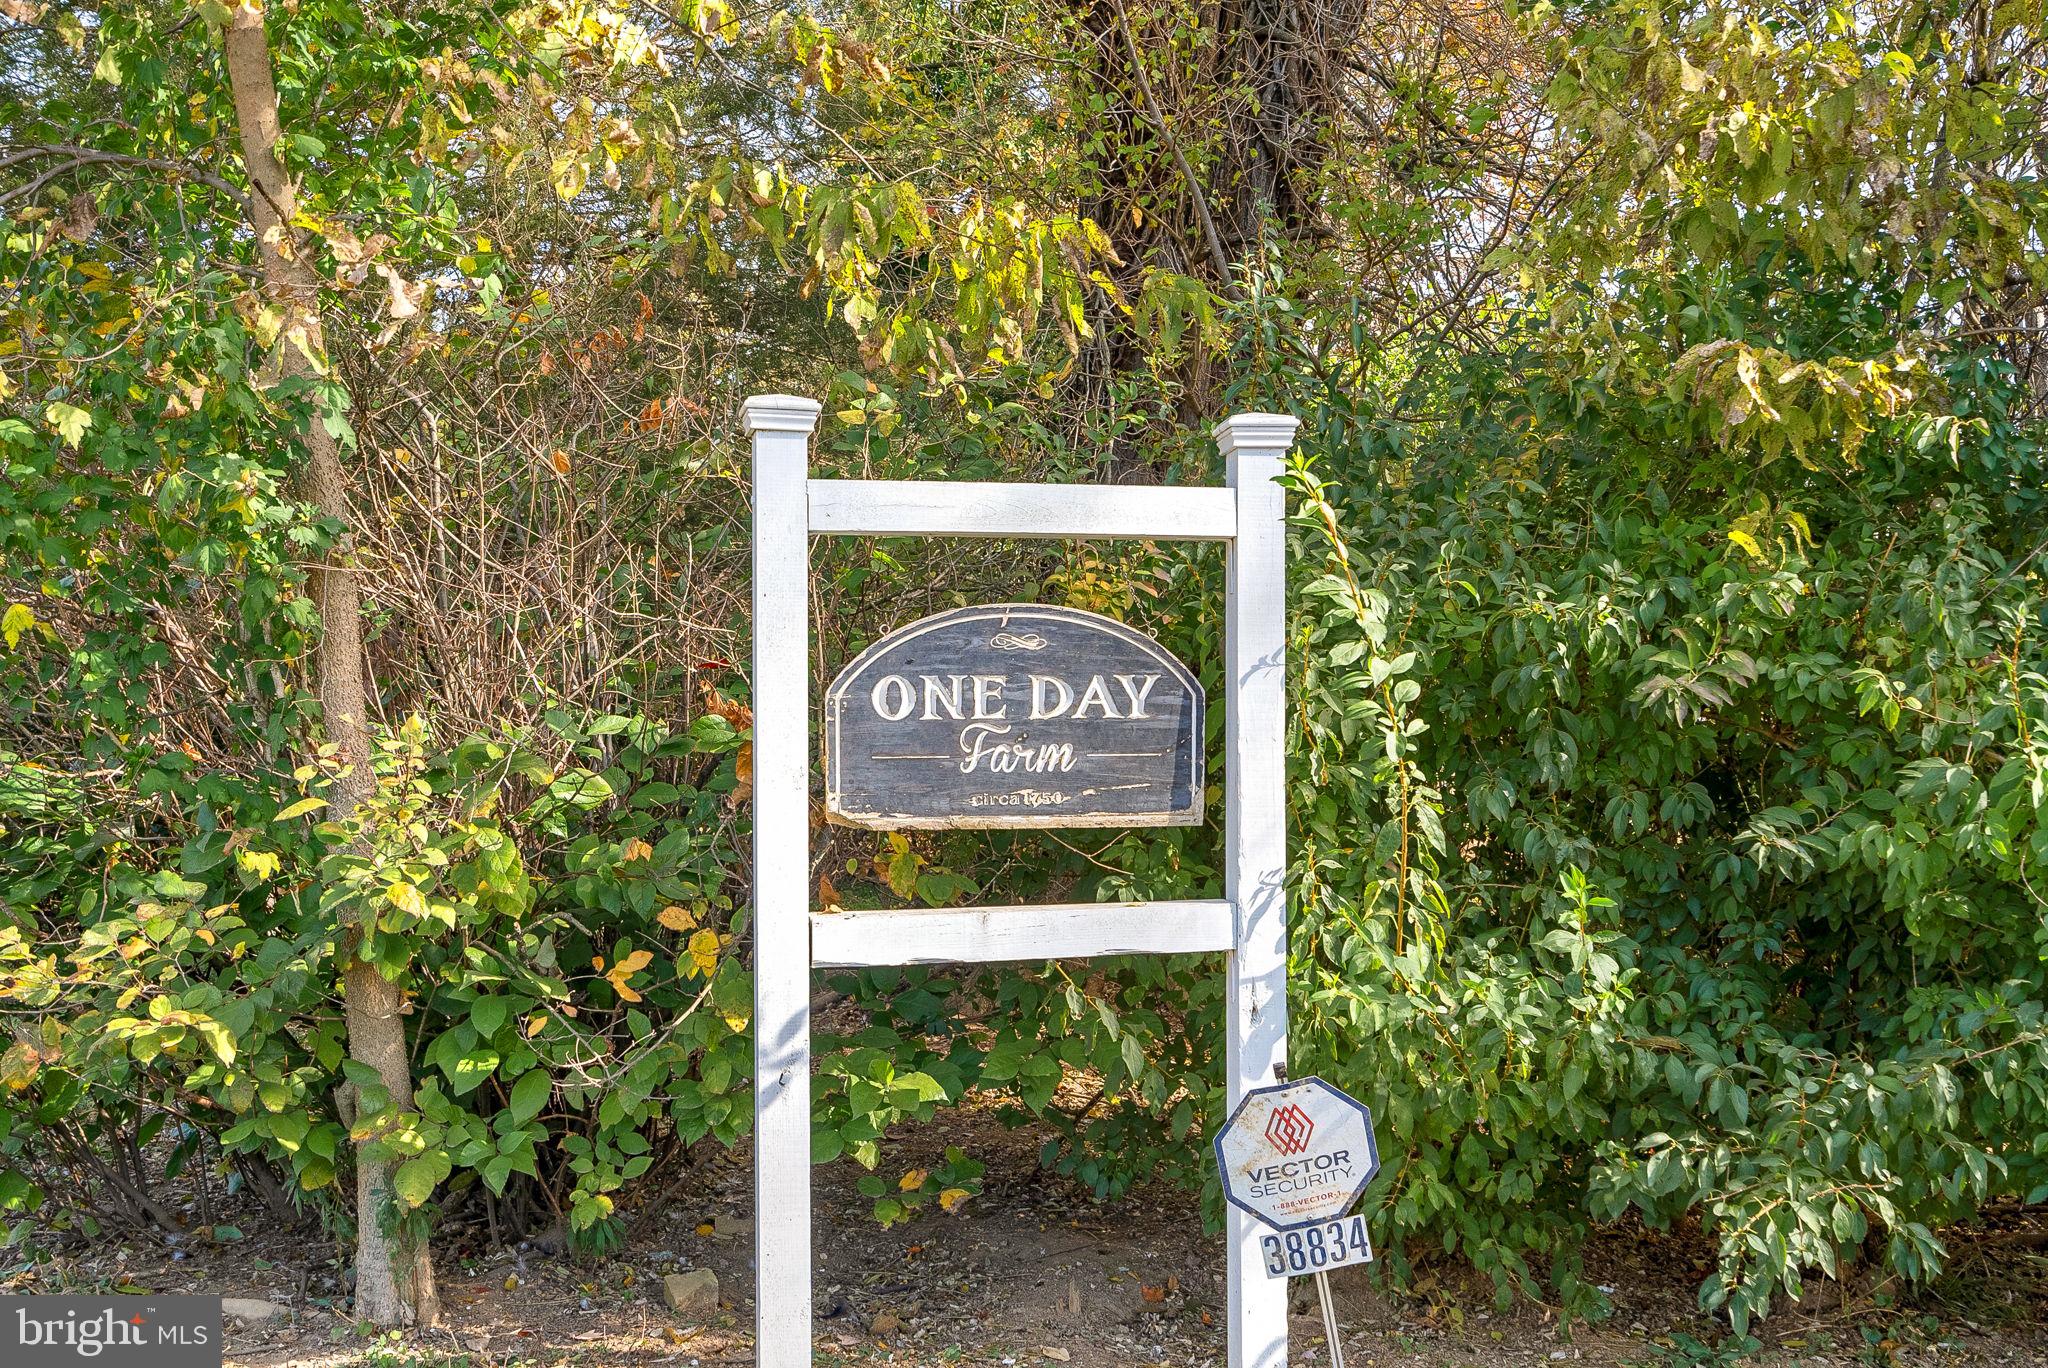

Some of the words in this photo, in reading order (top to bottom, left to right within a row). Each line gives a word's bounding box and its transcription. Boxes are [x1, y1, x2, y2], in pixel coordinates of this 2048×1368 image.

[871, 674, 1007, 721] ONE
[1028, 674, 1161, 720] DAY
[959, 723, 1078, 774] Farm
[969, 793, 1019, 806] circa
[1247, 1150, 1350, 1183] VECTOR
[1250, 1165, 1352, 1199] SECURITY
[1272, 1190, 1341, 1211] 1-888-VECTOR-1
[1263, 1216, 1368, 1275] 38834
